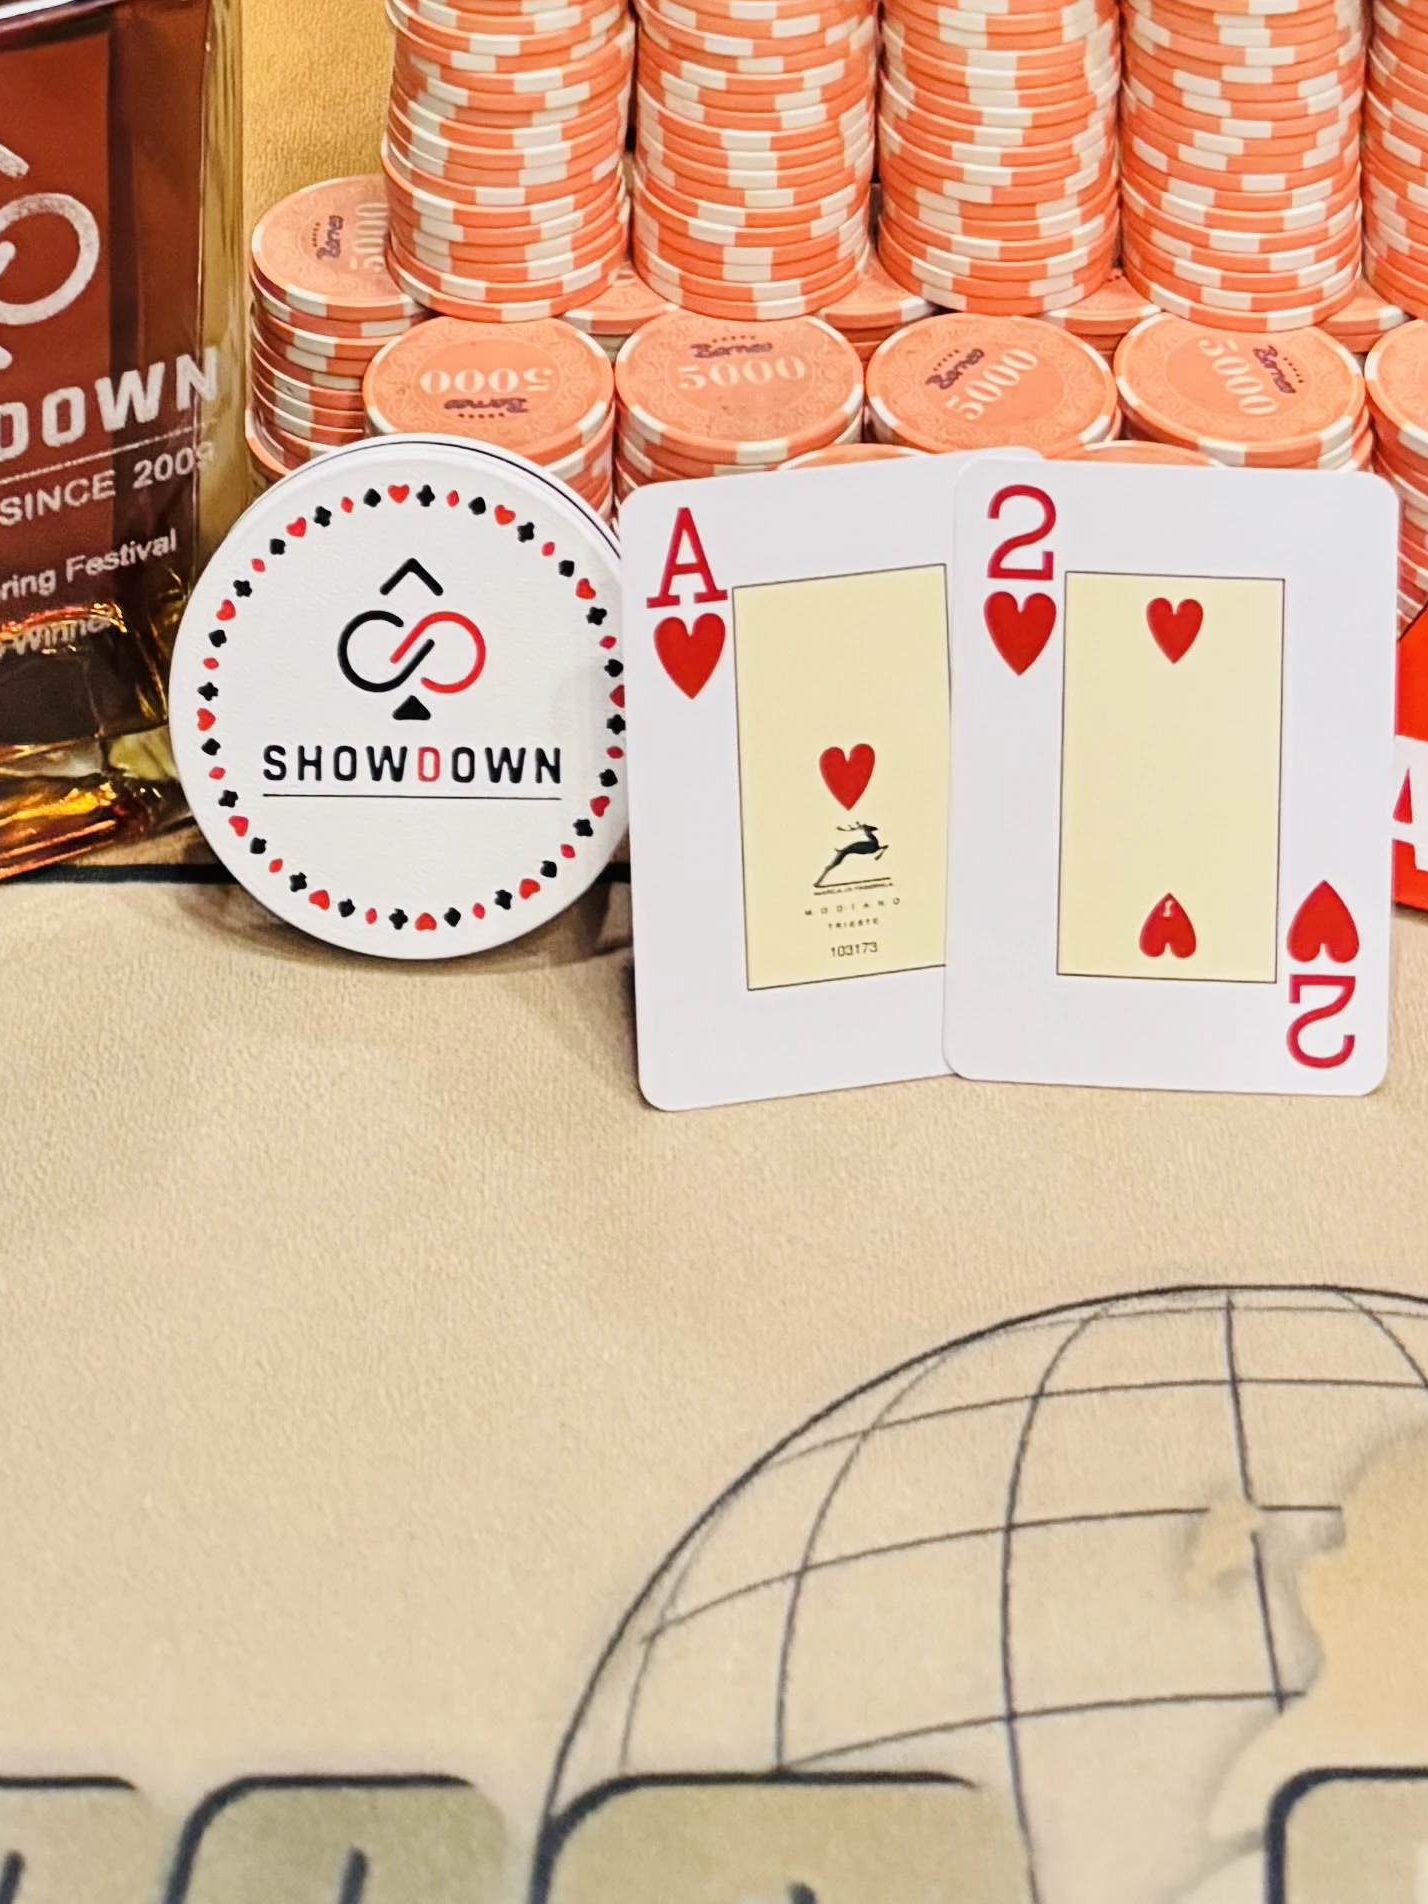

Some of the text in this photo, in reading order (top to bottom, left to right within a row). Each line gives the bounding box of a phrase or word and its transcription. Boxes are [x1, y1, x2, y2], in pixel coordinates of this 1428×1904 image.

[420, 368, 553, 394] 5000
[677, 356, 806, 390] 5000
[945, 349, 1038, 421] 5000
[1198, 339, 1278, 415] 5000
[66, 527, 177, 583] Festival
[646, 507, 729, 609] A
[987, 484, 1057, 581] 2
[263, 745, 562, 784] SHOWDOWN
[804, 896, 901, 916] MODIANO
[830, 941, 879, 958] 103173
[1286, 974, 1357, 1070] 2
